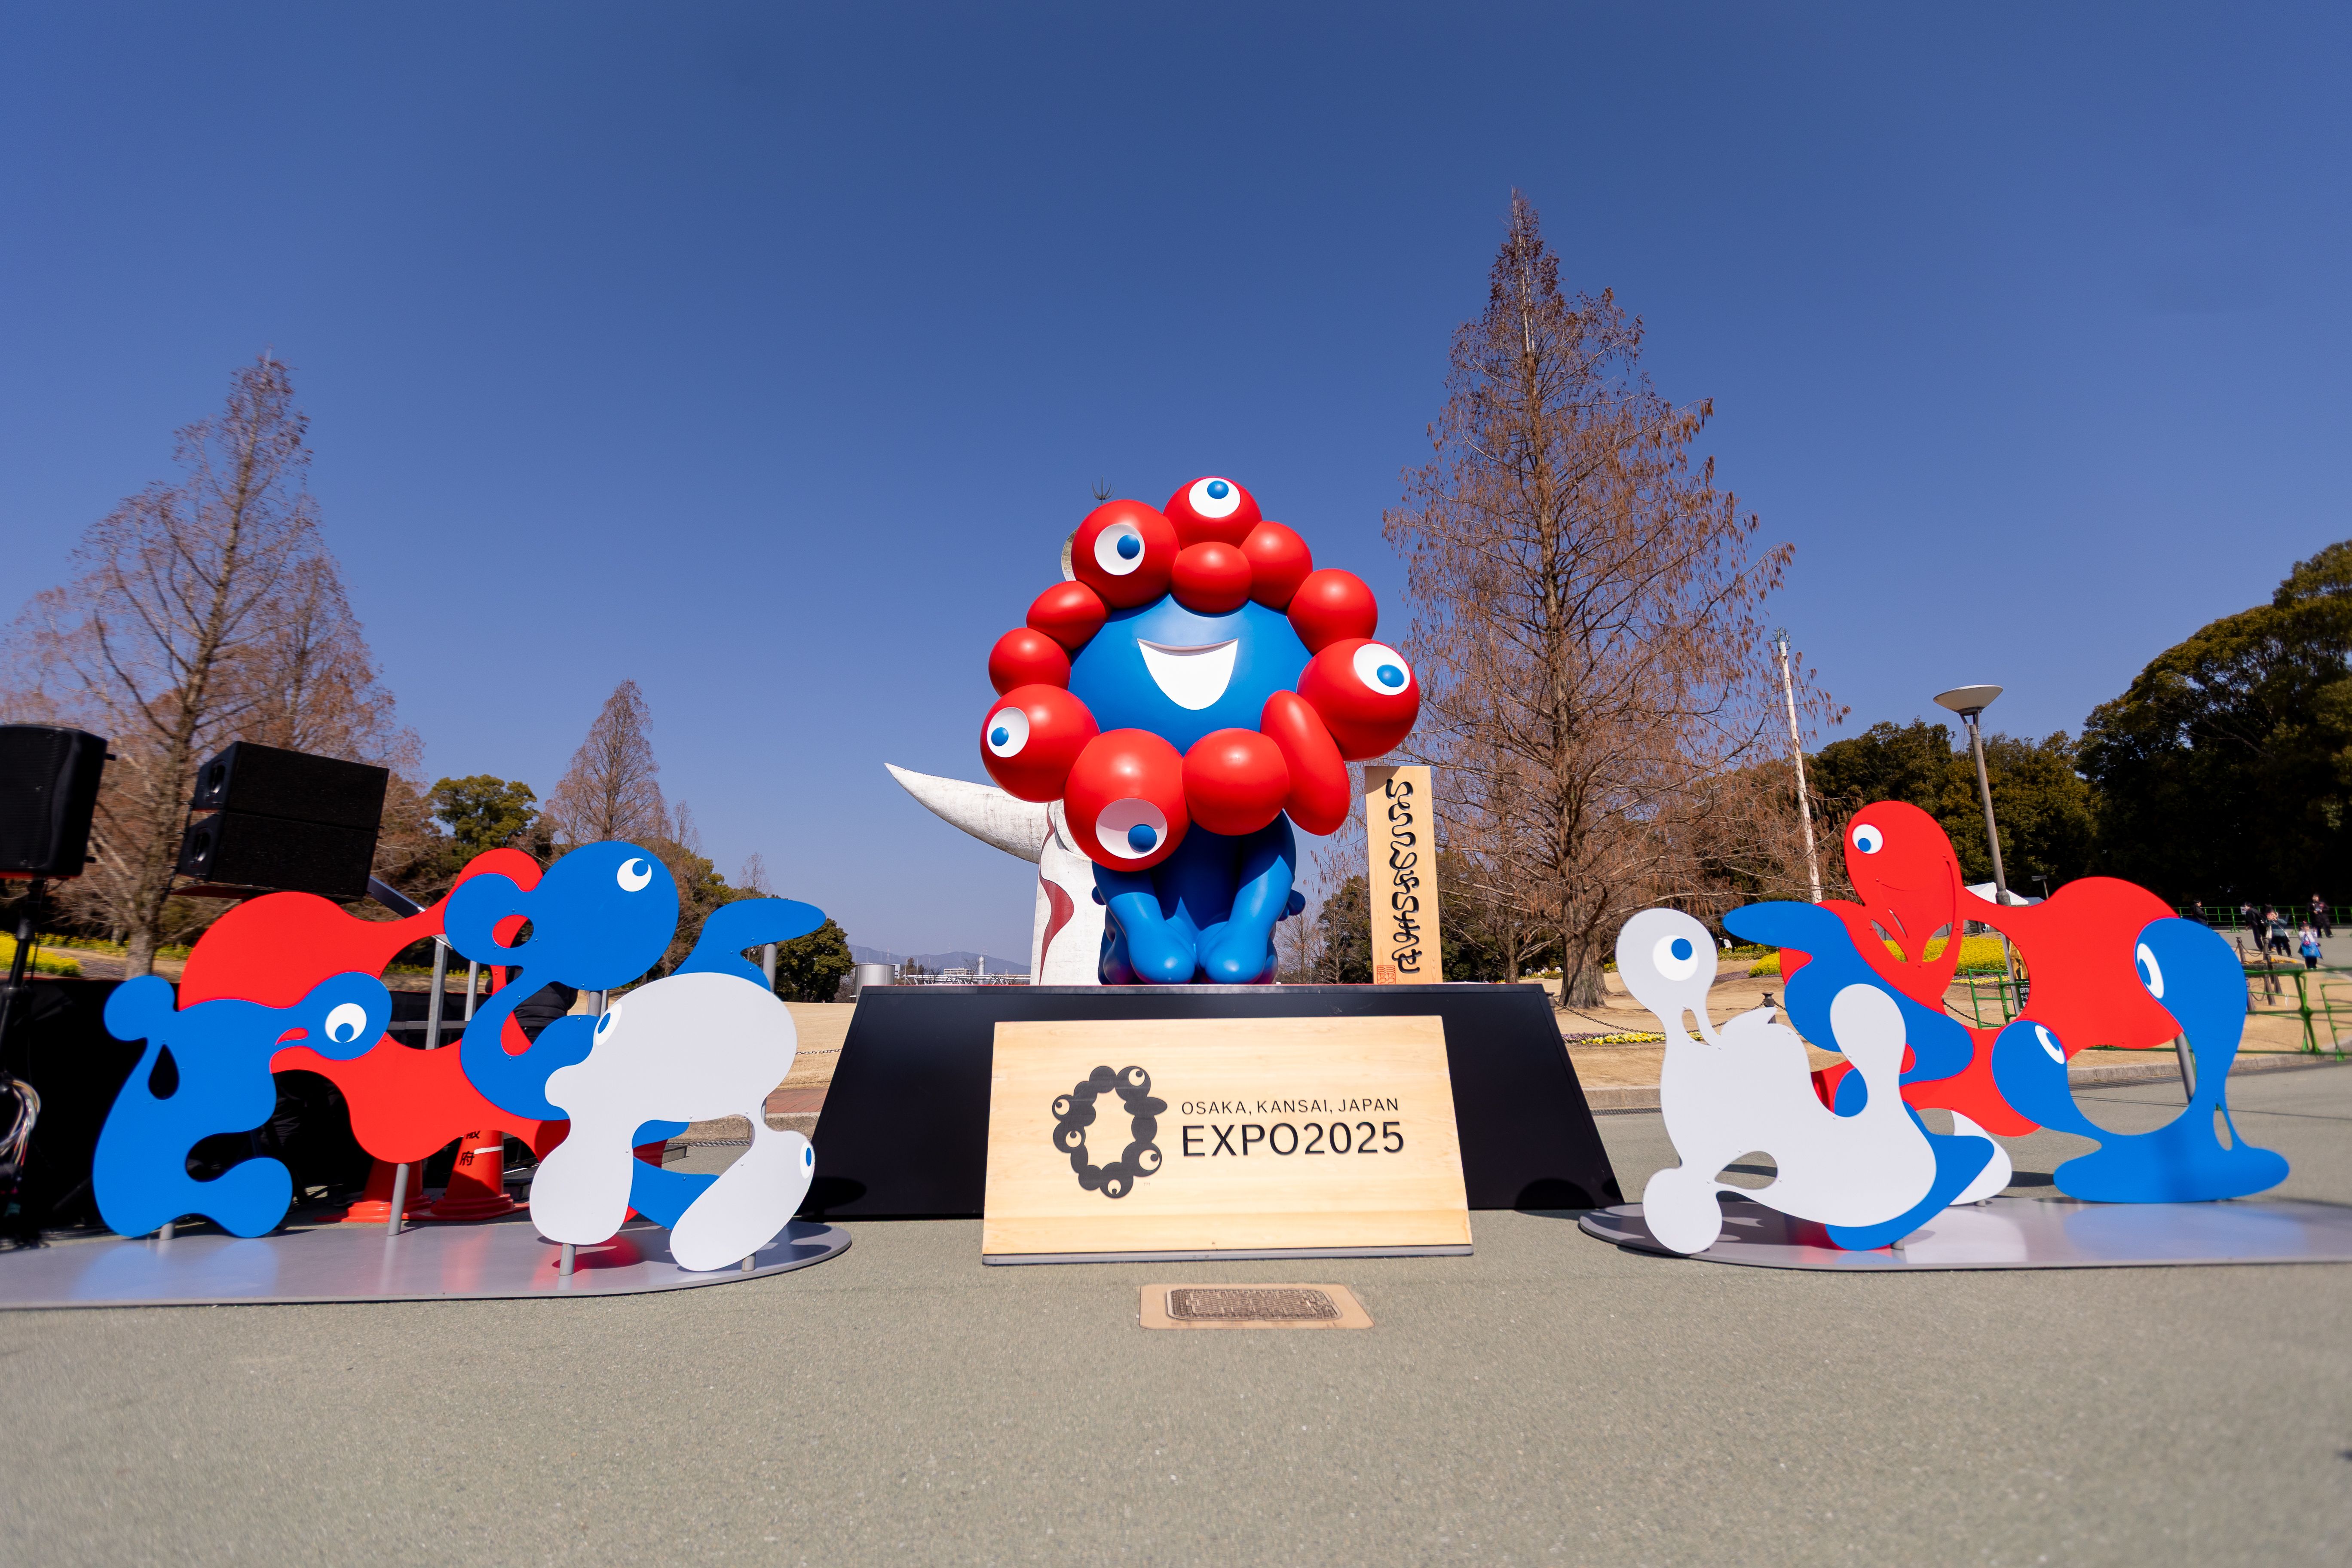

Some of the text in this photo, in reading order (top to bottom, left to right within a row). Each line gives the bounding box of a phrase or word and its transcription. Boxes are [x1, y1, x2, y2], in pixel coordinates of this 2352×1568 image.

[1182, 1098, 1399, 1115] OSAKA, KANSAI, JAPAN
[1182, 1121, 1404, 1157] EXPO2025
